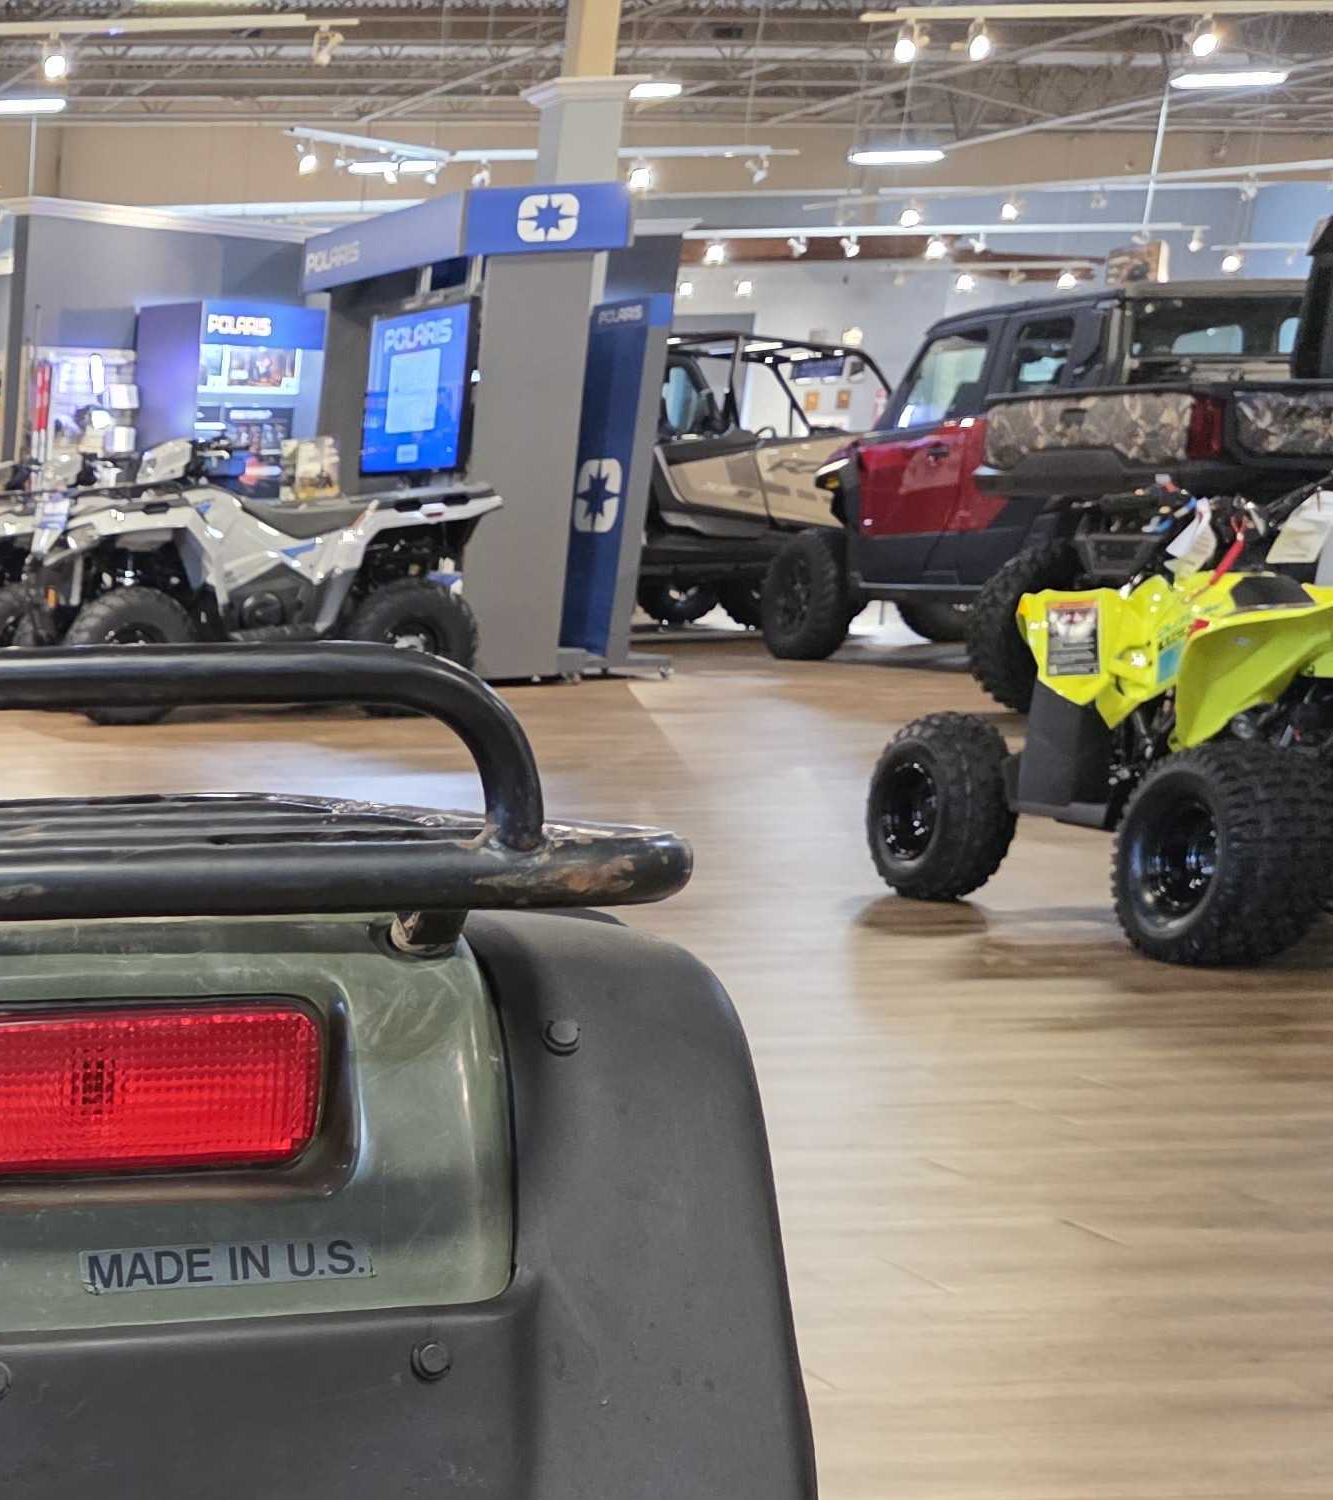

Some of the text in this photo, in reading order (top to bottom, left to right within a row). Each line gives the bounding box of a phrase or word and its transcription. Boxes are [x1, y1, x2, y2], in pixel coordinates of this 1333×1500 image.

[207, 313, 272, 337] POLARIS
[384, 317, 453, 352] POLARIS
[88, 1248, 214, 1289] MADE
[229, 1244, 271, 1281] IN
